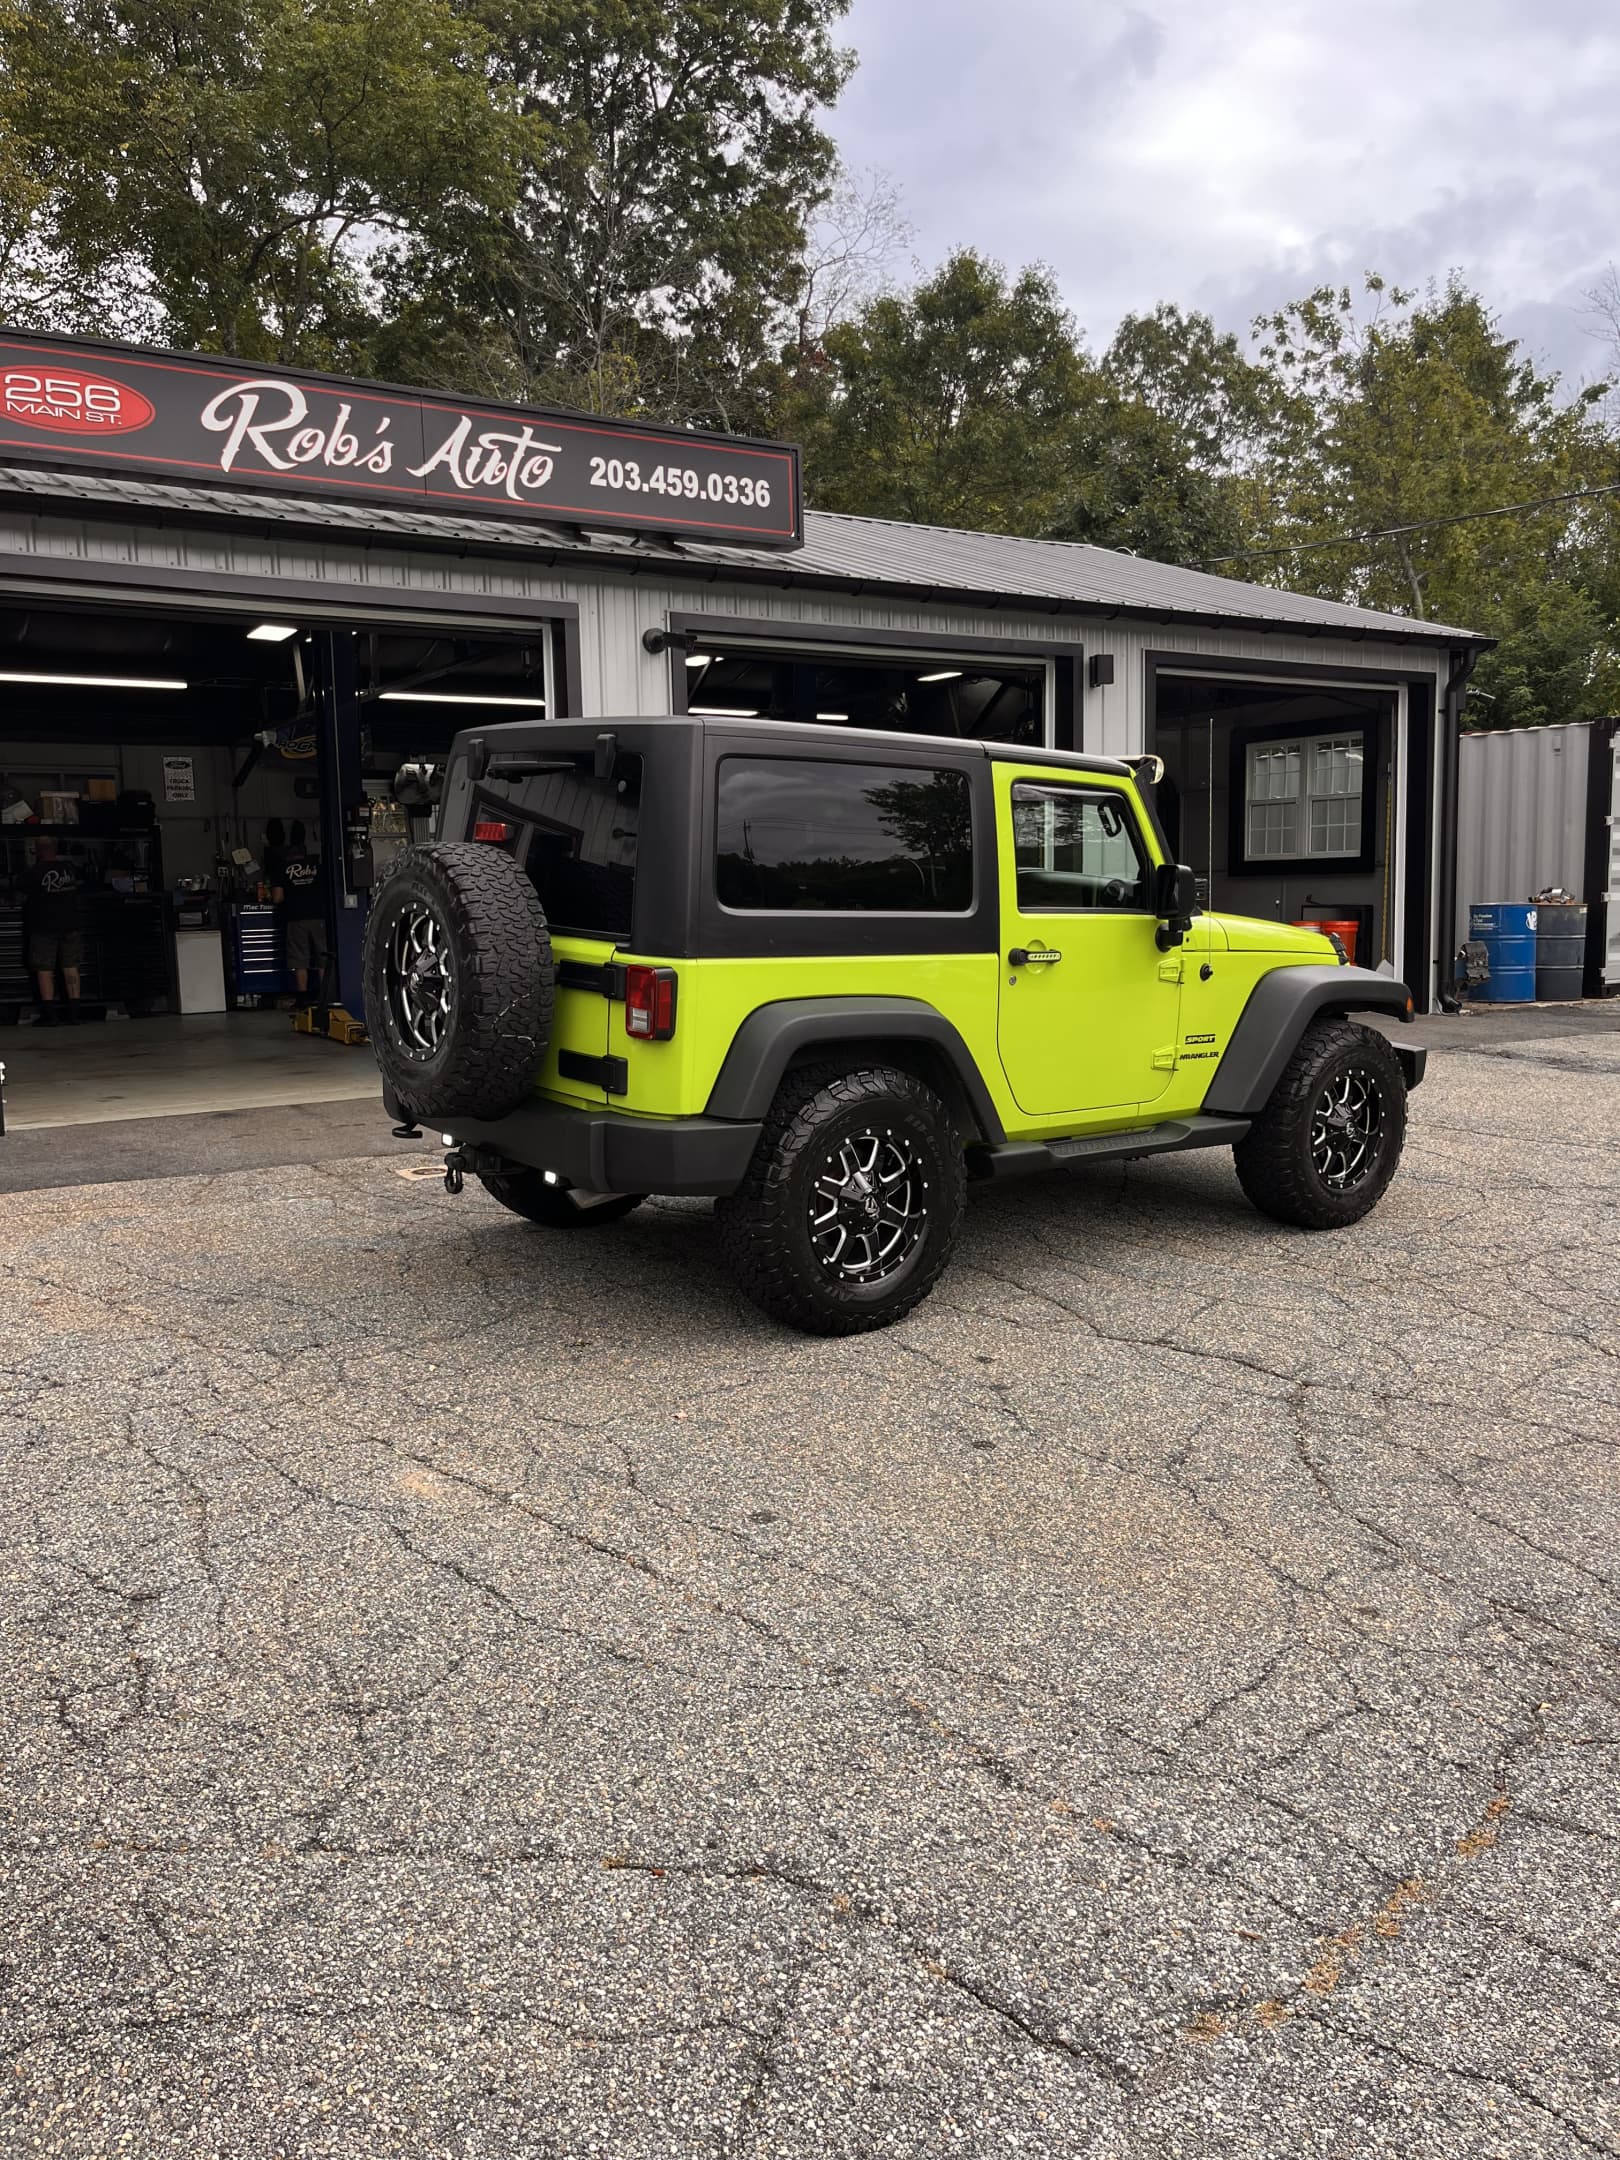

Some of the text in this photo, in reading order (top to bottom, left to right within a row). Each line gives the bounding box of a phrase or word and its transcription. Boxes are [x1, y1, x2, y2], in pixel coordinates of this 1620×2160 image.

[4, 374, 120, 412] 256
[6, 401, 122, 425] MAIN ST.
[201, 379, 771, 508] Rob's Auto 203.459.0336
[1185, 1034, 1215, 1045] SPORT
[1179, 1051, 1219, 1060] WRANGLER
